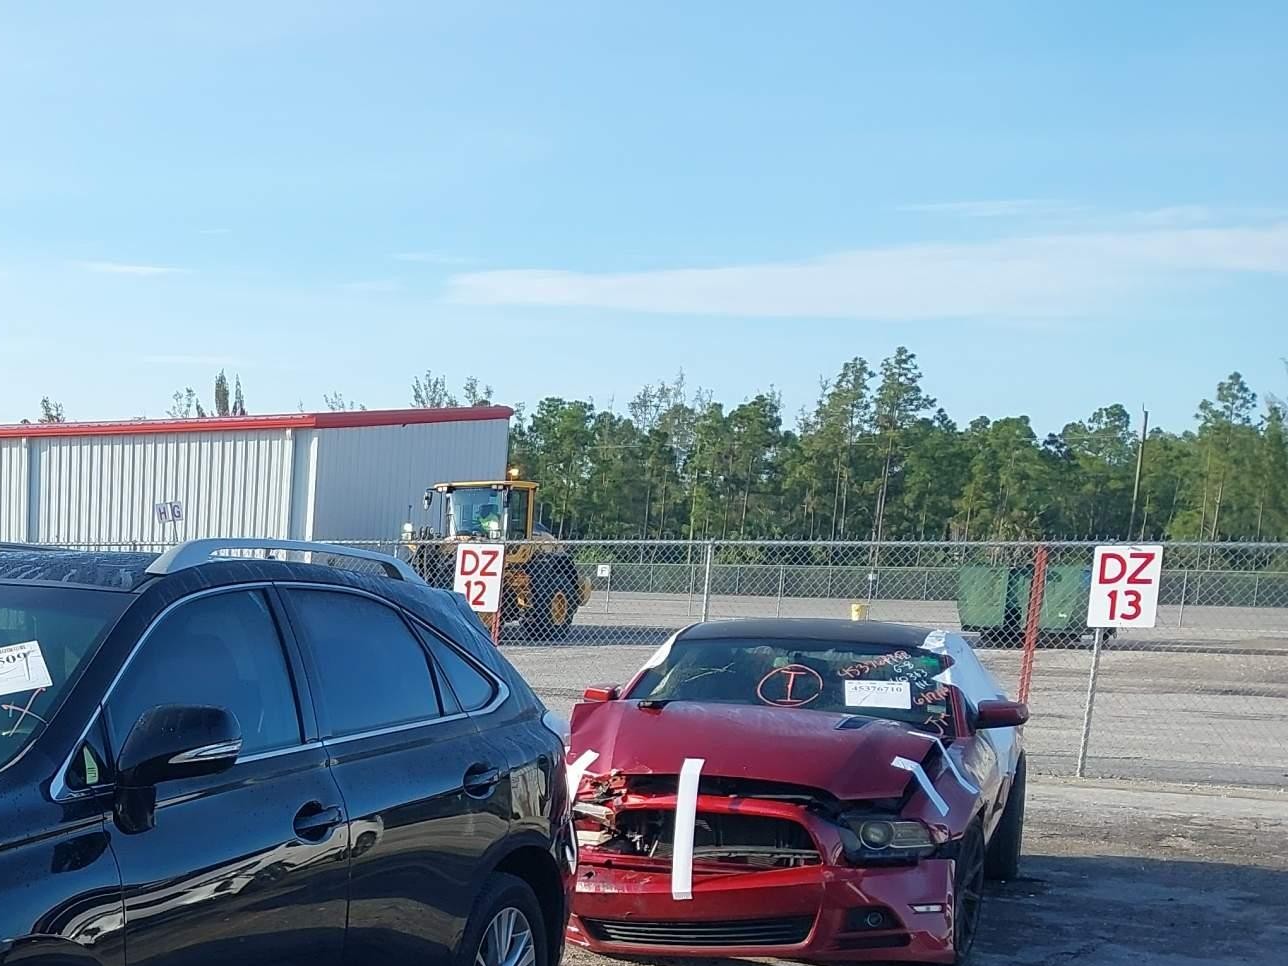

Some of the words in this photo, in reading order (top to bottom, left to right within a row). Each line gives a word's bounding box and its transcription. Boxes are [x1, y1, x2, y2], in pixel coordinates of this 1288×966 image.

[460, 550, 499, 576] DZ
[1098, 552, 1156, 584] DZ
[464, 580, 487, 605] 12
[1107, 589, 1142, 620] 13
